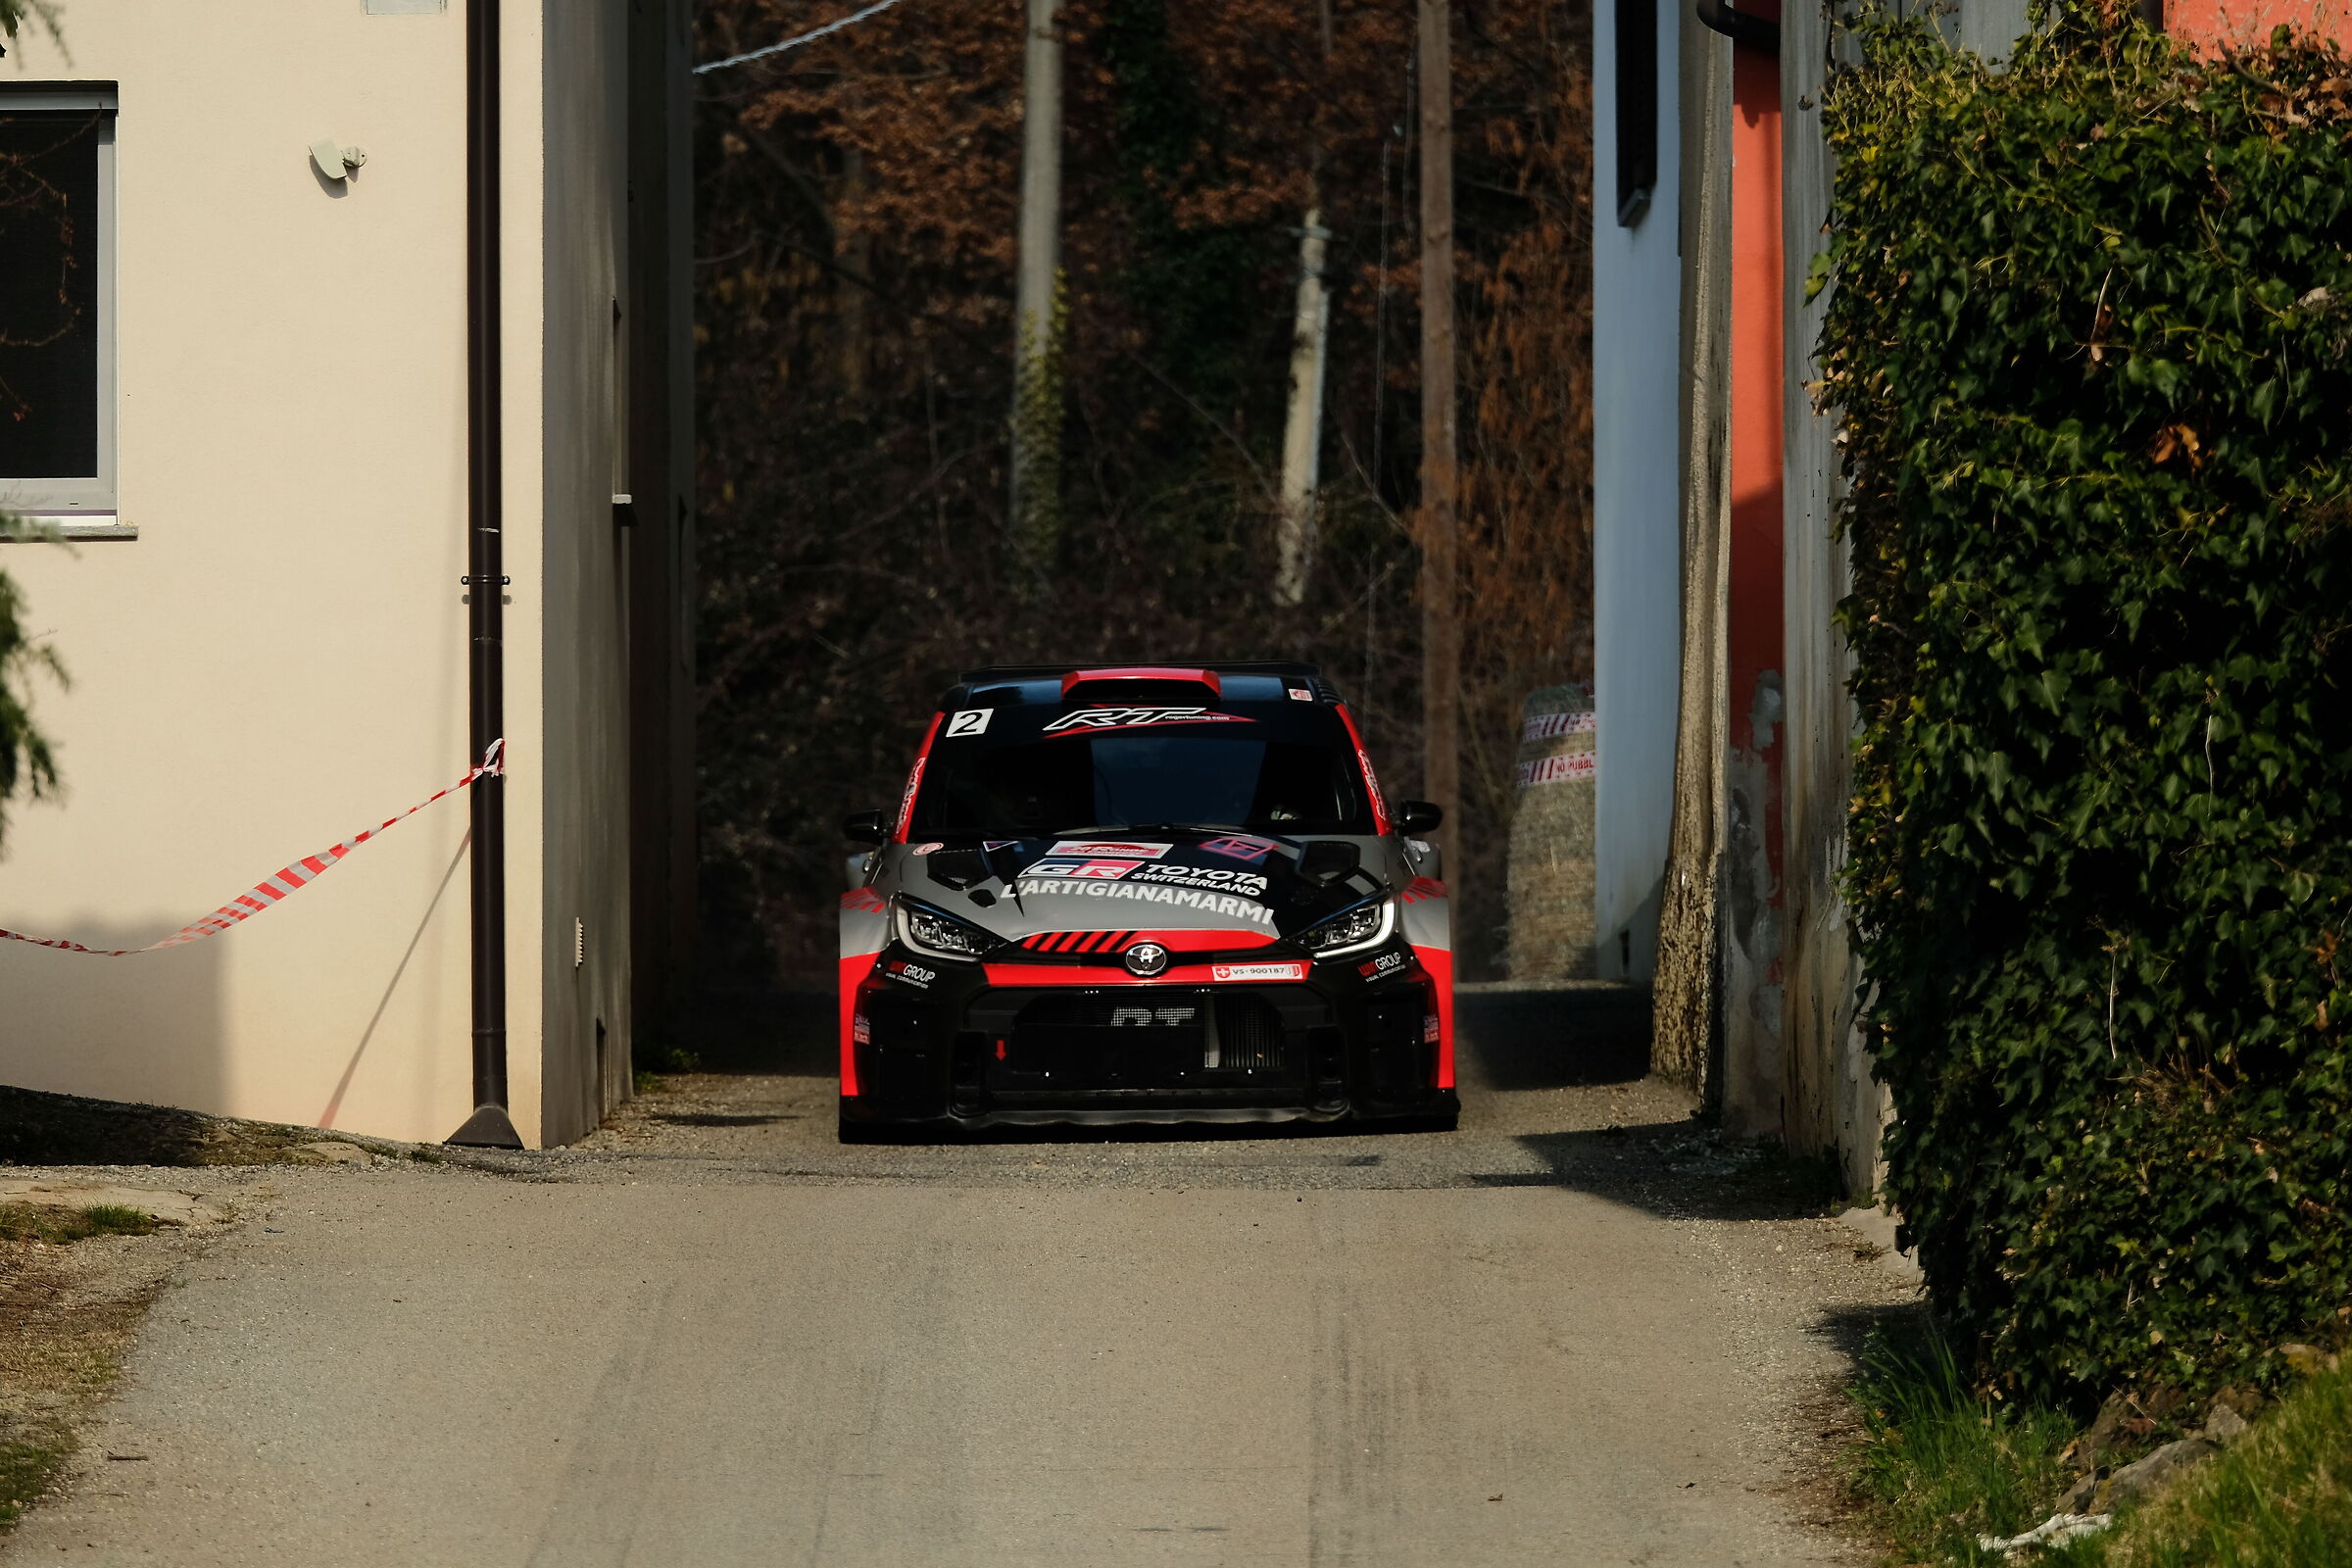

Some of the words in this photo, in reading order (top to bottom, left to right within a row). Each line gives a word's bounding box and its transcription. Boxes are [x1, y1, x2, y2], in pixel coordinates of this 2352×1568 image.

[957, 711, 984, 733] 2
[1042, 707, 1206, 731] RT
[1026, 863, 1128, 878] GR
[1145, 863, 1268, 890] TOYOTA
[1130, 872, 1261, 897] SWITZERLAND
[1000, 879, 1275, 925] L'ARTIGIANAMARMI
